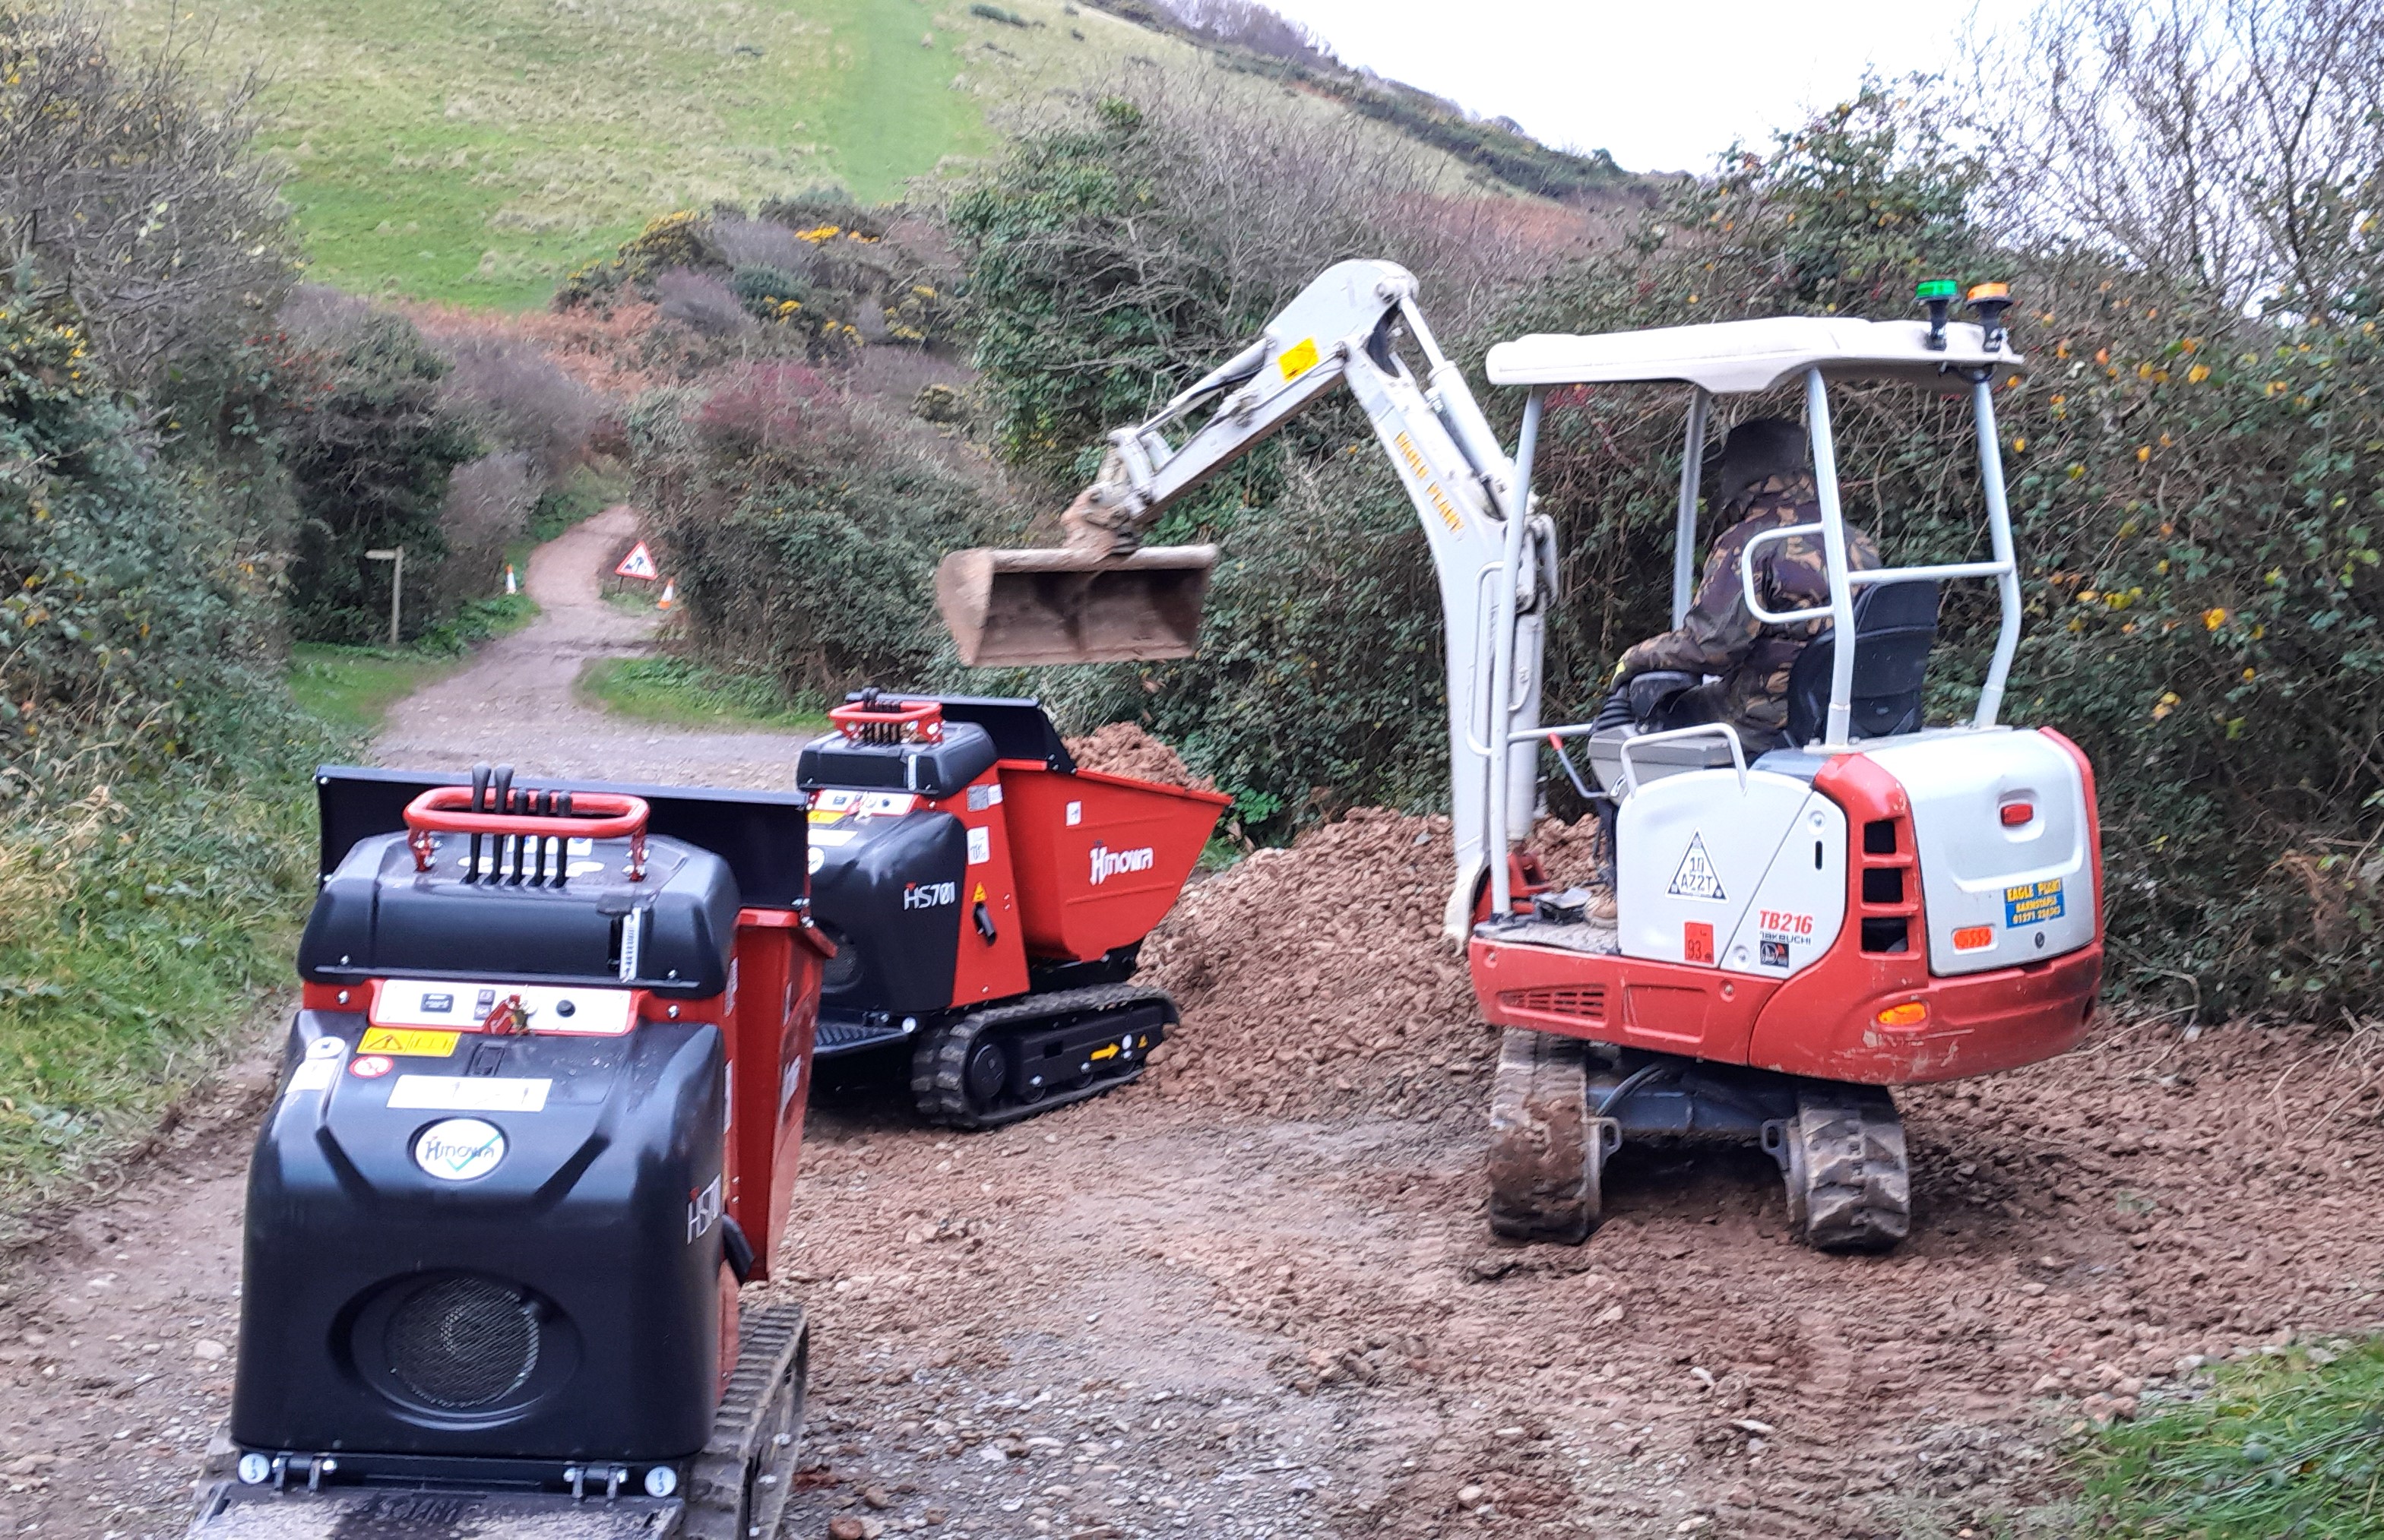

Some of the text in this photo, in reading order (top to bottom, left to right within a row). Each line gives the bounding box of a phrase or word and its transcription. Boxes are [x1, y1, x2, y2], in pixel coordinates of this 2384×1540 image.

[904, 881, 955, 910] HS701
[2006, 885, 2034, 902] EAGLE
[1760, 910, 1813, 935] TB216
[1686, 938, 1702, 959] 93
[1759, 931, 1811, 946] TAKEUCHI
